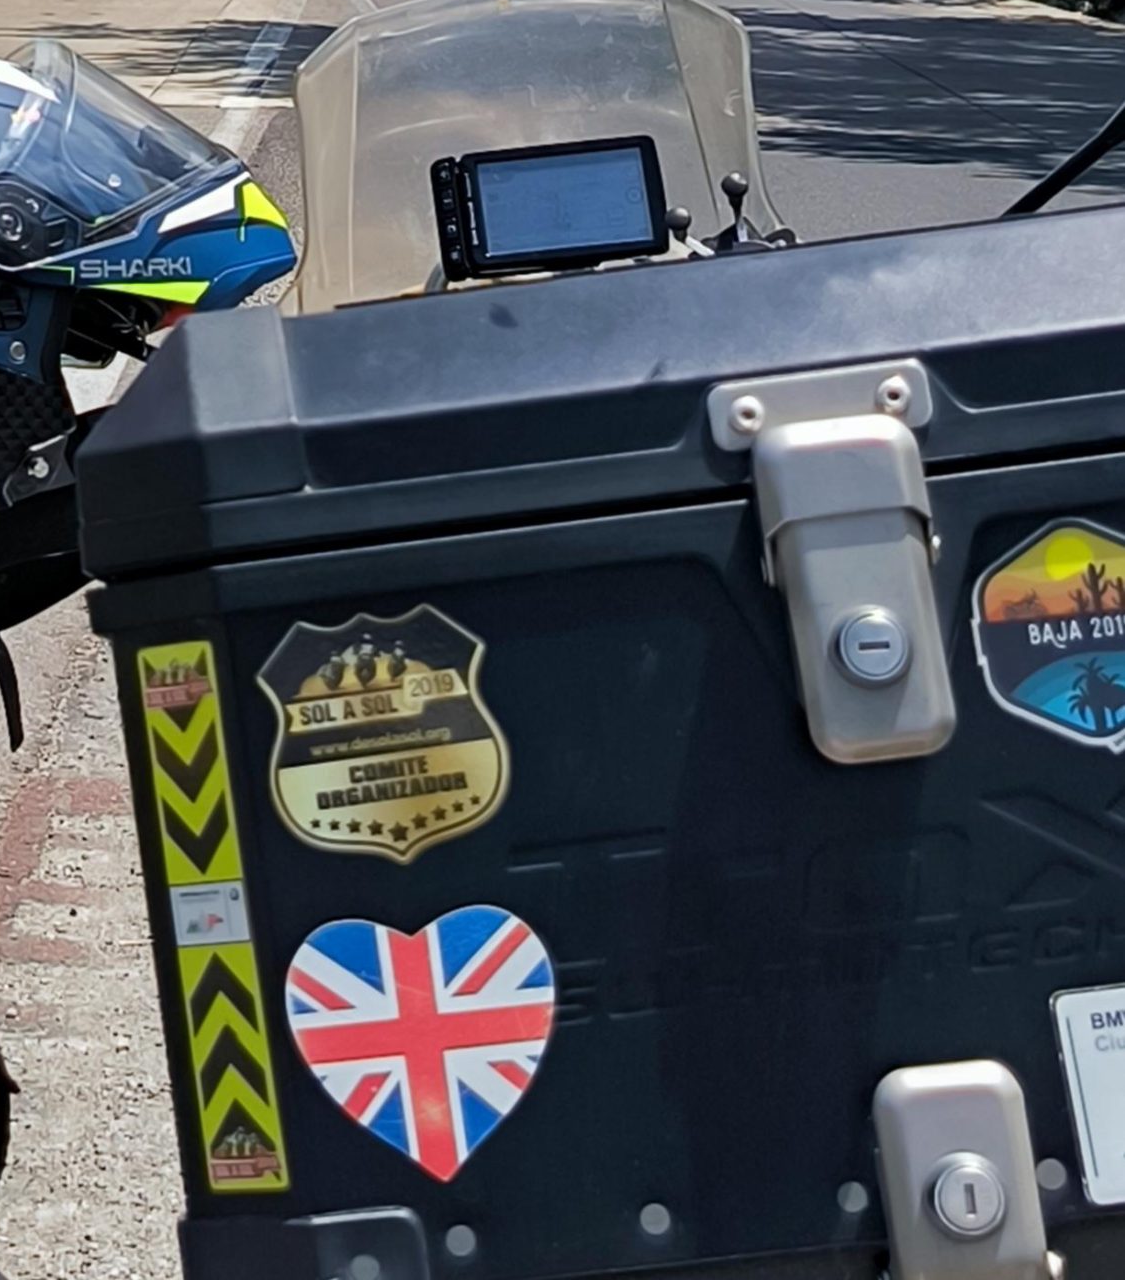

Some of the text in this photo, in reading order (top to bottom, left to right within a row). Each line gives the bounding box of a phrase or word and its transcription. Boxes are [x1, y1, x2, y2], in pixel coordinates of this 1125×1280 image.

[1028, 614, 1125, 649] BAJA 201
[409, 673, 454, 697] 2019
[299, 693, 399, 725] SOL A SOL
[349, 755, 429, 784] COMITE
[316, 772, 468, 810] ORGANIZADOR
[1090, 1010, 1125, 1029] BM
